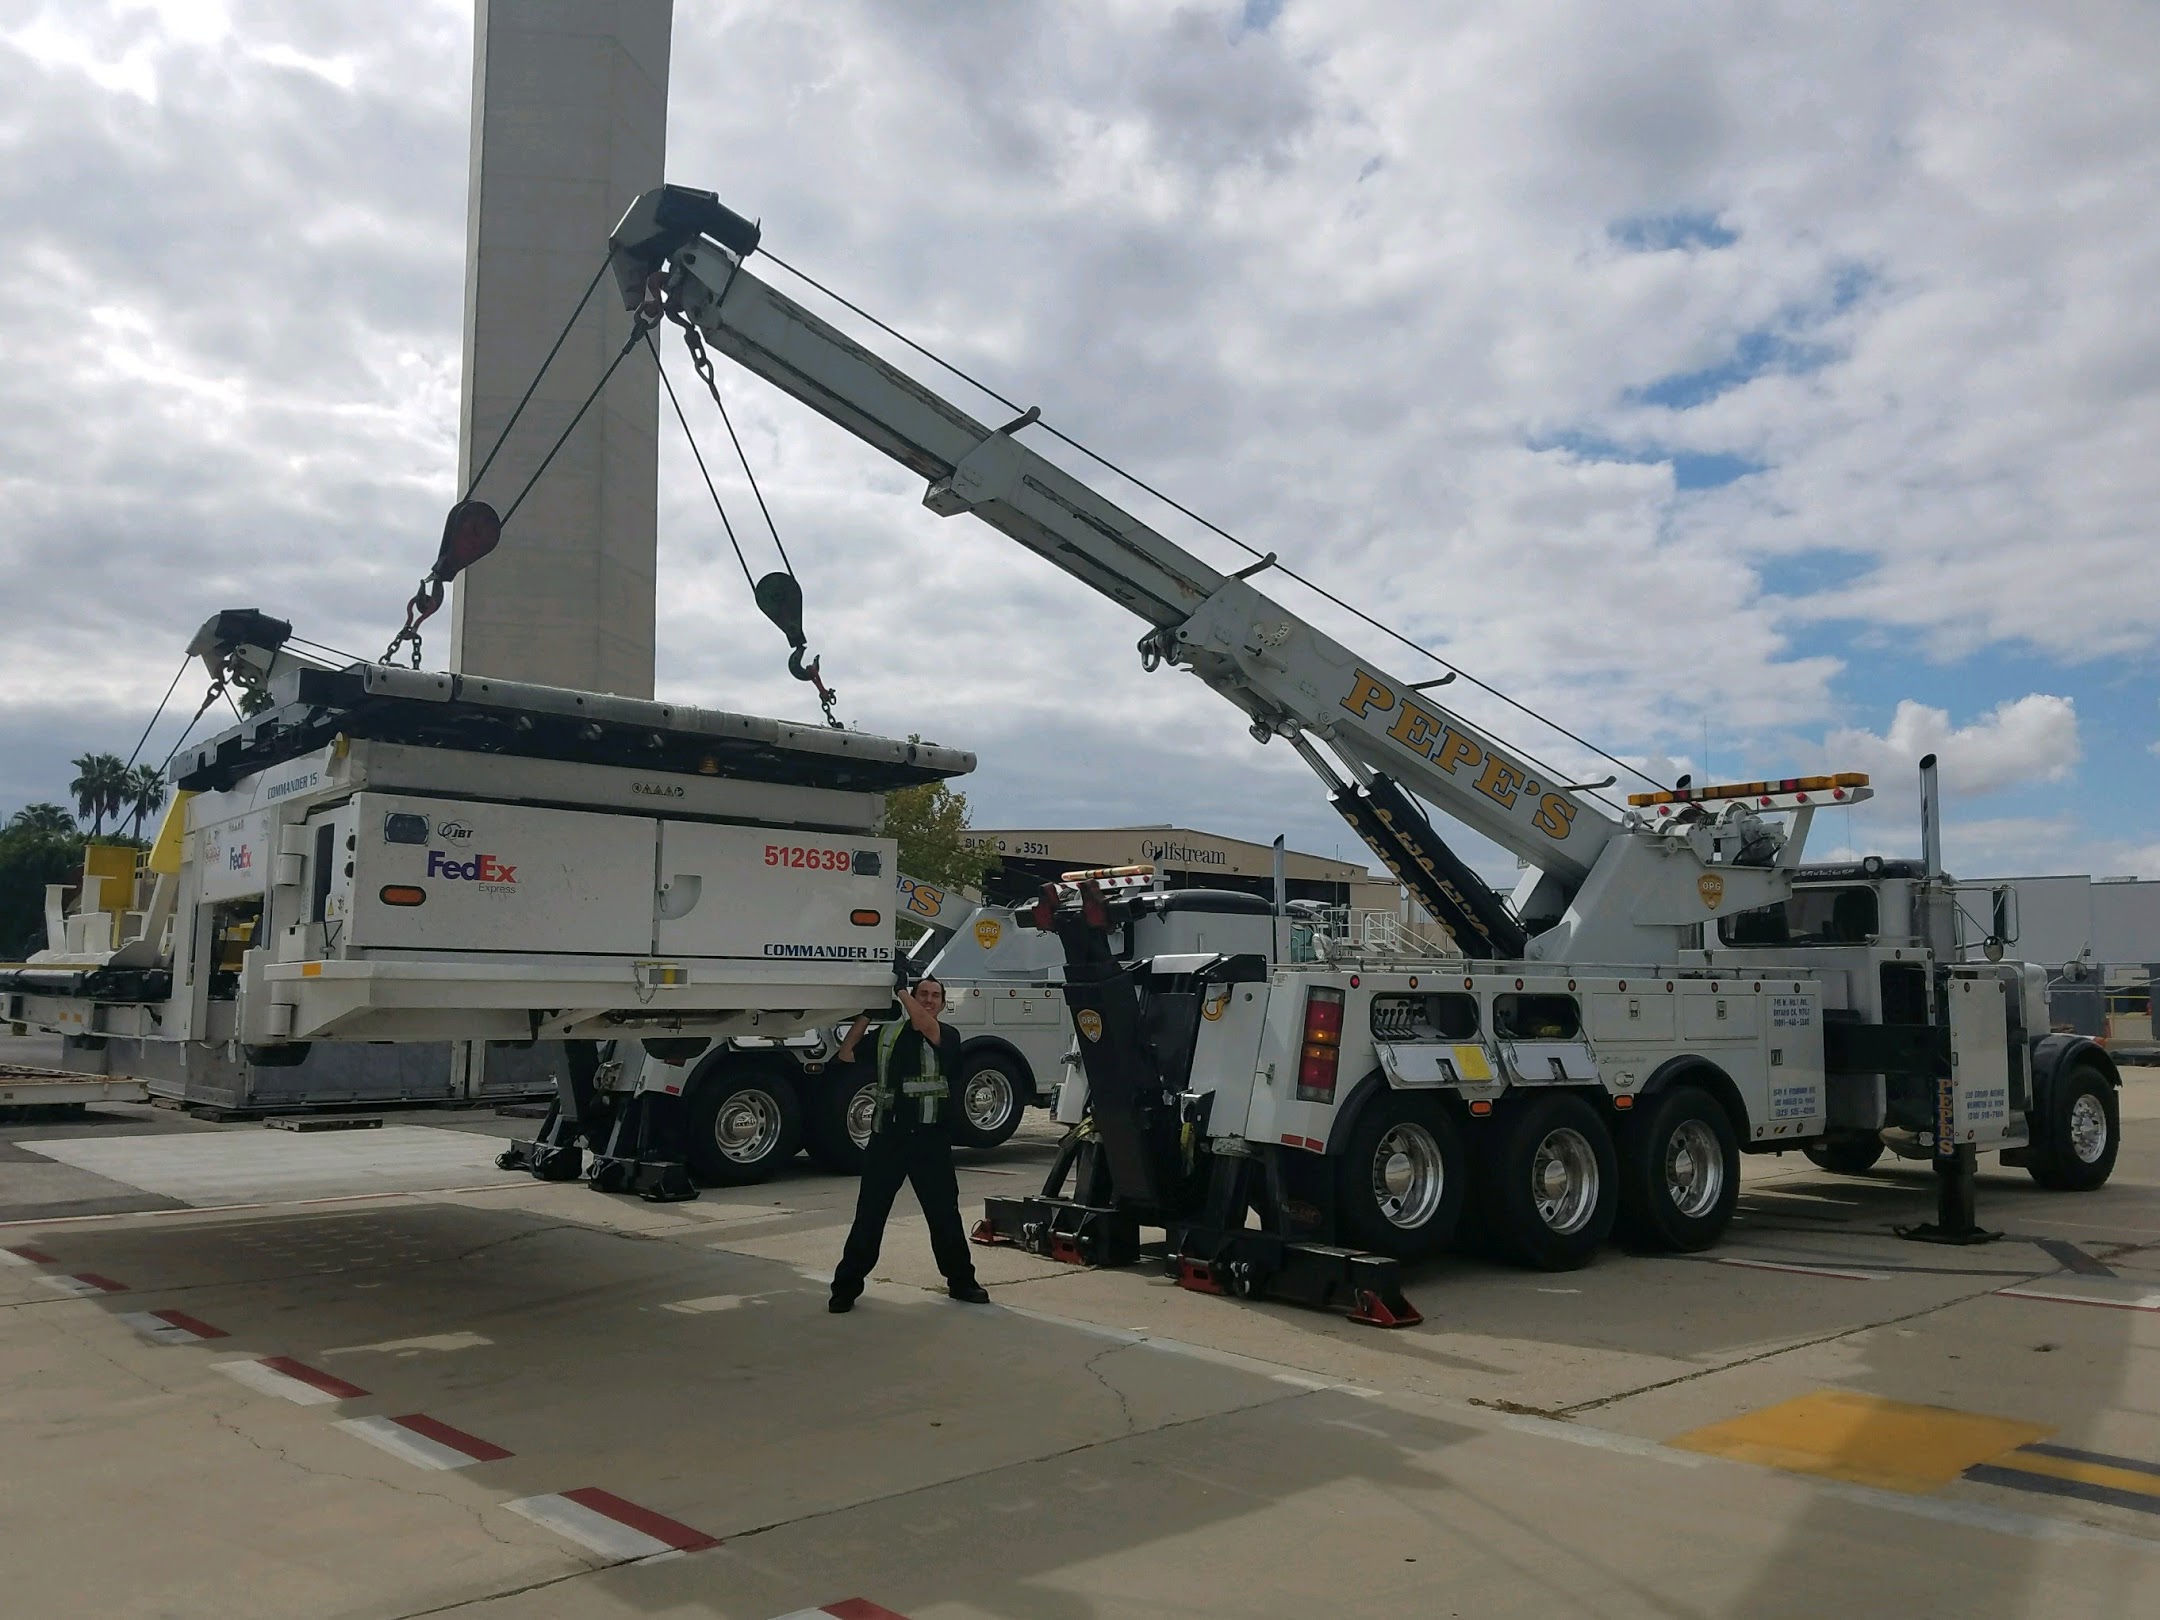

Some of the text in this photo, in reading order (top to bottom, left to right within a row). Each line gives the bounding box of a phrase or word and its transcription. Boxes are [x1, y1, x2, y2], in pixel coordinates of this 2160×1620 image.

[1340, 668, 1578, 840] PEPE'S
[268, 776, 307, 799] COMMANDER
[452, 829, 474, 839] JBT
[1023, 842, 1049, 856] 3521
[1141, 839, 1226, 865] Gulfstream
[229, 844, 252, 871] FedEx
[764, 845, 850, 872] 512639
[427, 850, 517, 884] FedEx
[478, 882, 516, 894] Express
[1702, 881, 1721, 891] OPG
[979, 926, 998, 935] OPG
[763, 943, 868, 959] COMMANDER
[1081, 1016, 1098, 1024] OPG
